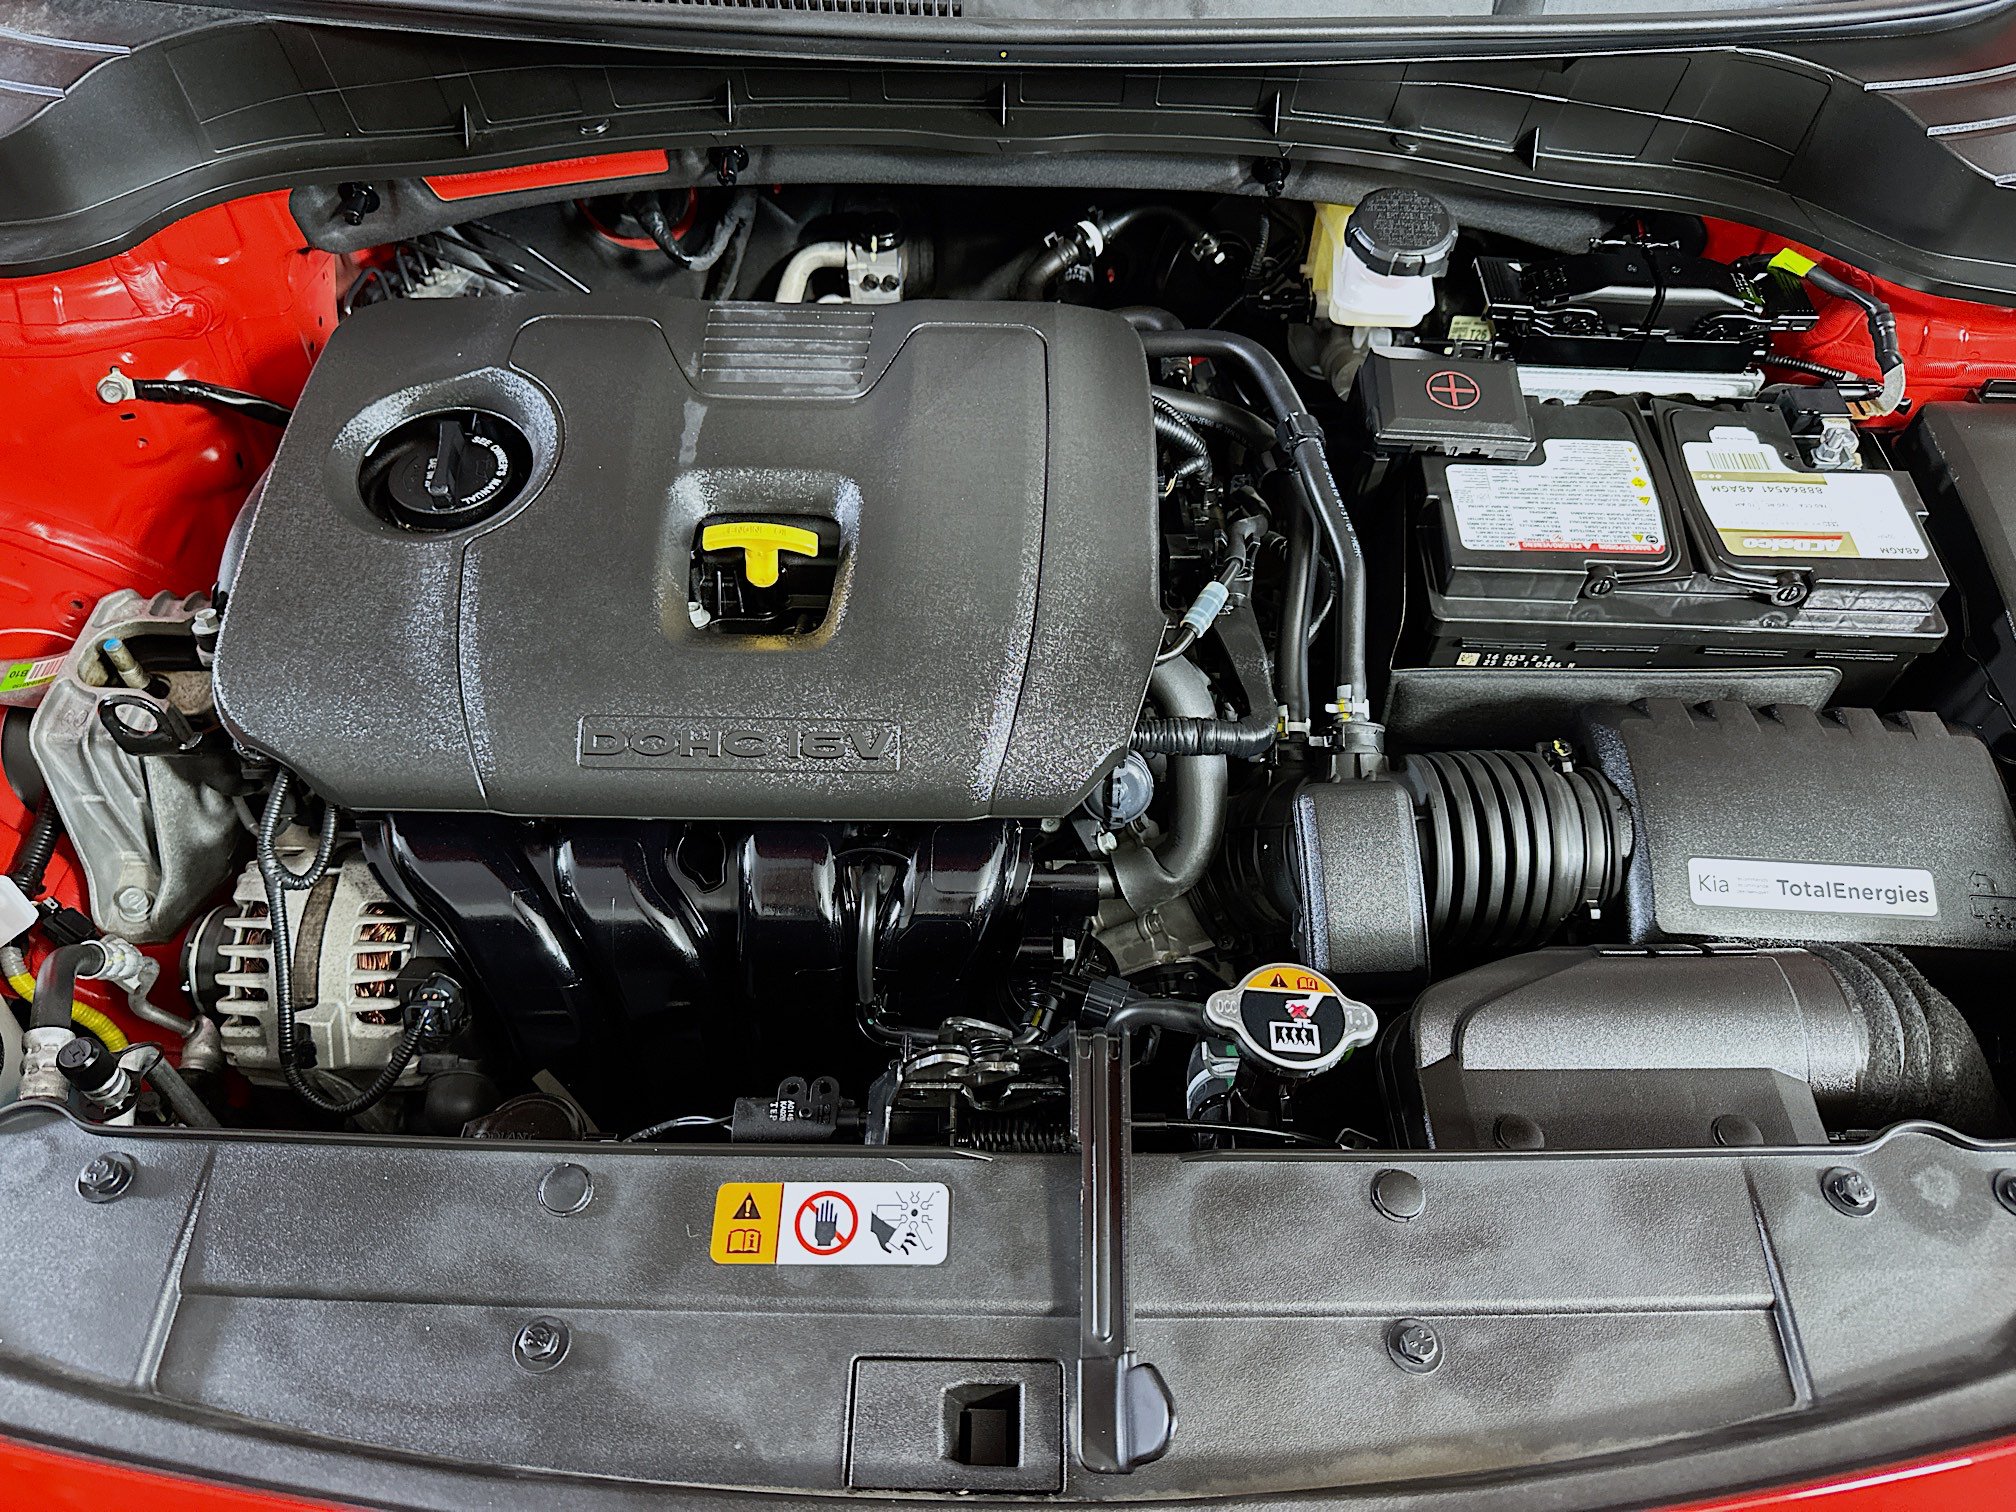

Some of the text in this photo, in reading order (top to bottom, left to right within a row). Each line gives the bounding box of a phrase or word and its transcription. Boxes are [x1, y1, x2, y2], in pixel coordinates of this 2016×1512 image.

[471, 435, 493, 448] SEE
[460, 478, 503, 505] MANUAL
[1711, 485, 1823, 494] 88864541 48AGM
[1743, 538, 1843, 552] ACDelco
[1879, 546, 1920, 555] 48AGM
[9, 669, 31, 679] B10
[583, 729, 895, 760] DOHC 16V
[1698, 873, 1729, 893] Kia
[1776, 878, 1930, 905] TotalEnergies
[1215, 999, 1368, 1026] DCC 1.1
